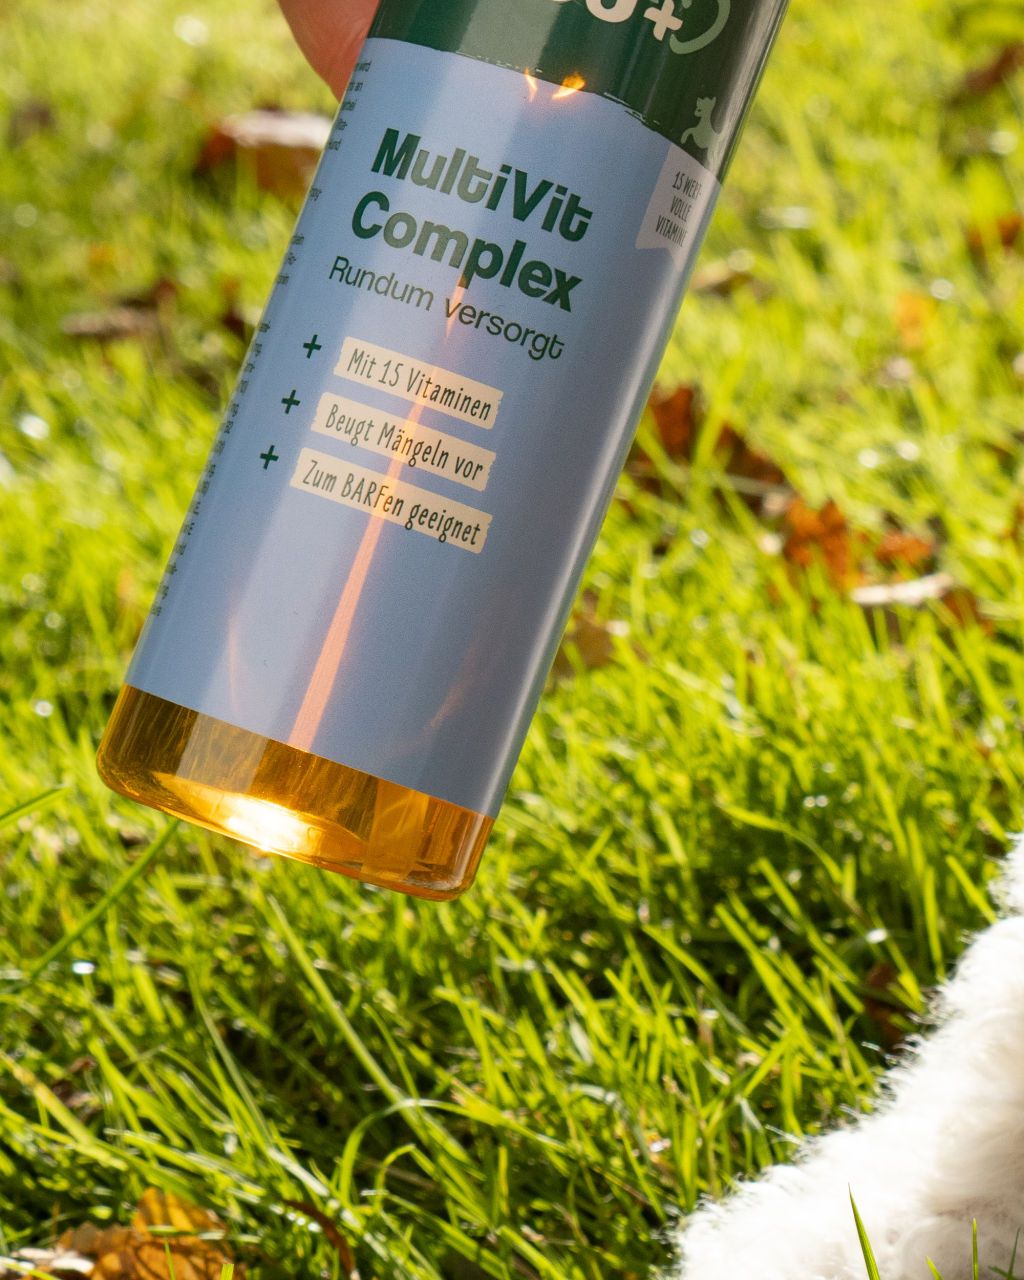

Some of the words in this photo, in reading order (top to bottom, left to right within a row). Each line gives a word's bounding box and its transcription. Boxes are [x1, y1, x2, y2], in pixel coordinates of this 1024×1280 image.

[371, 127, 594, 243] MultiVit
[671, 170, 686, 191] 15
[351, 191, 583, 312] Complex
[328, 255, 435, 312] Rundum
[444, 297, 565, 361] versorgt
[347, 347, 376, 380] Mit
[377, 359, 402, 388] 15
[406, 367, 492, 422] Vitaminen
[325, 403, 375, 447] Beugt
[376, 421, 450, 470] Mängeln
[454, 456, 484, 482] vor
[301, 459, 337, 494] Zum
[341, 472, 404, 518] BARFen
[404, 501, 482, 546] geeignet
